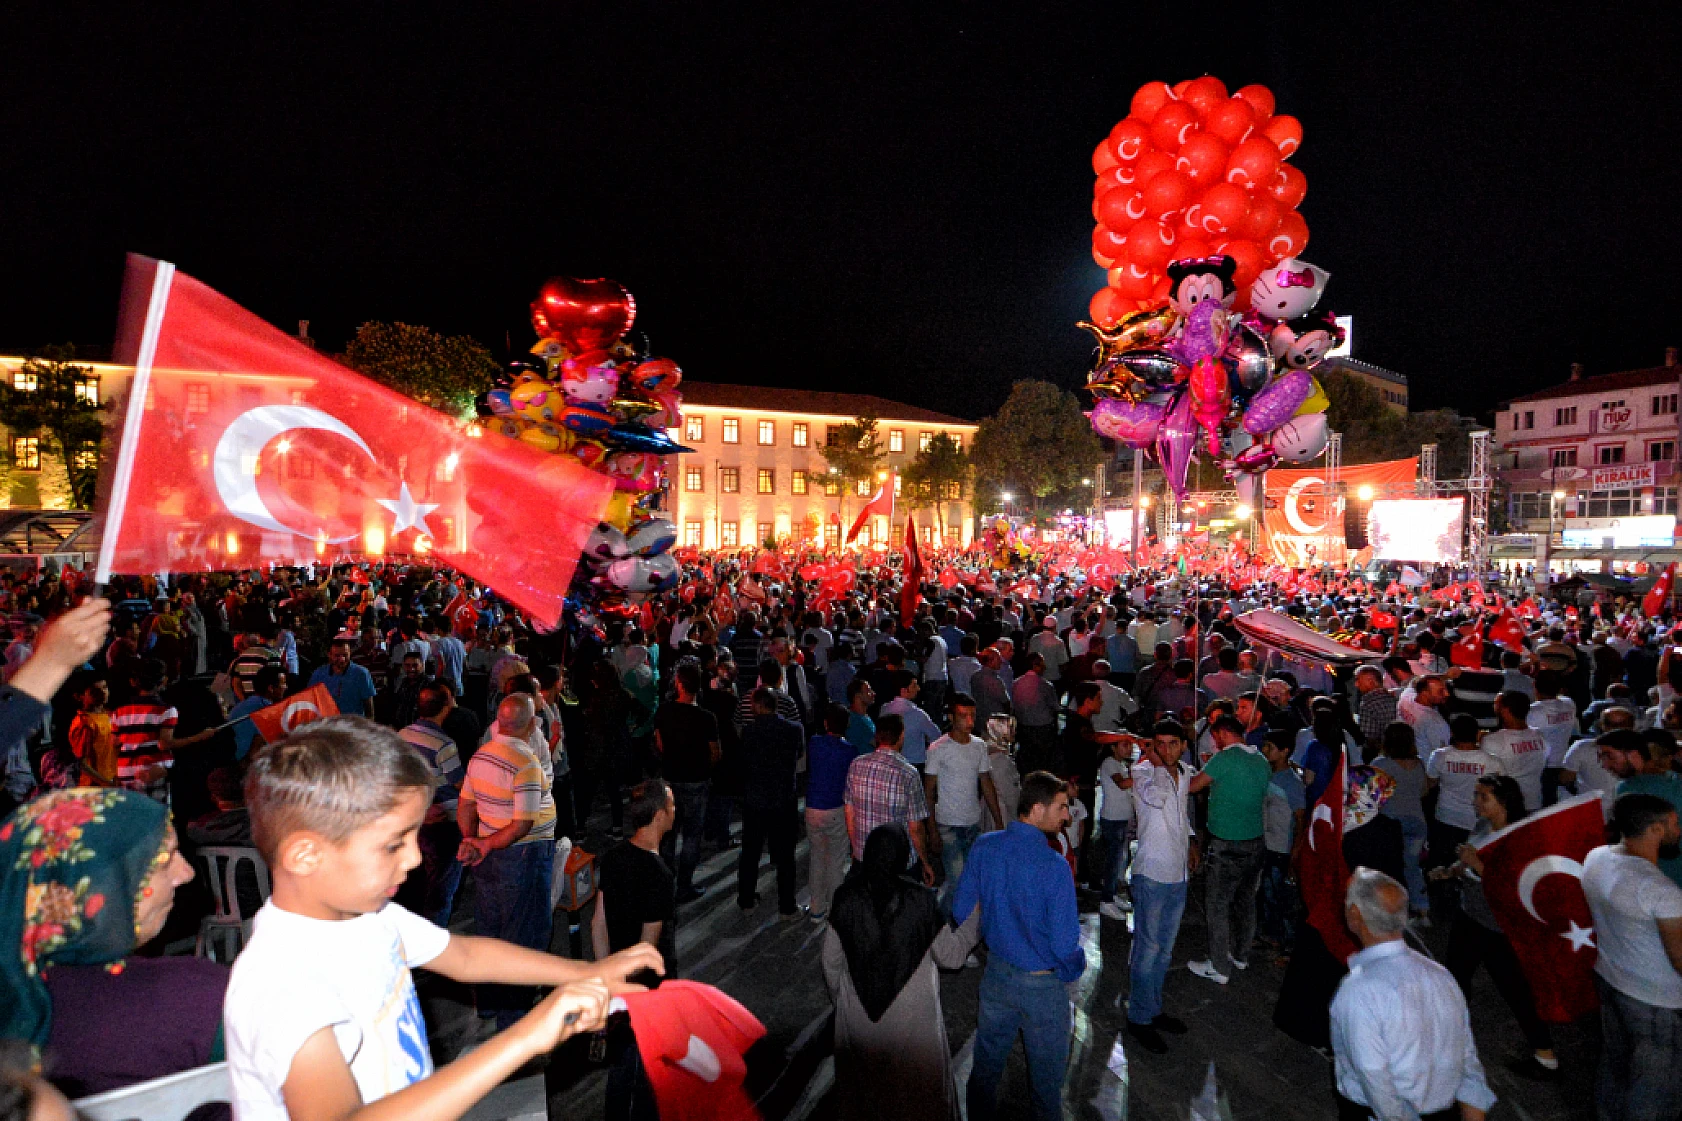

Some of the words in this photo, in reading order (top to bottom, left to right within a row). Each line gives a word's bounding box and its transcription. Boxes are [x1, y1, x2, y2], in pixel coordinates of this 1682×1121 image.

[1595, 468, 1652, 484] KIRALIK
[1510, 739, 1544, 755] TURKEY
[1446, 761, 1485, 776] TURKEY
